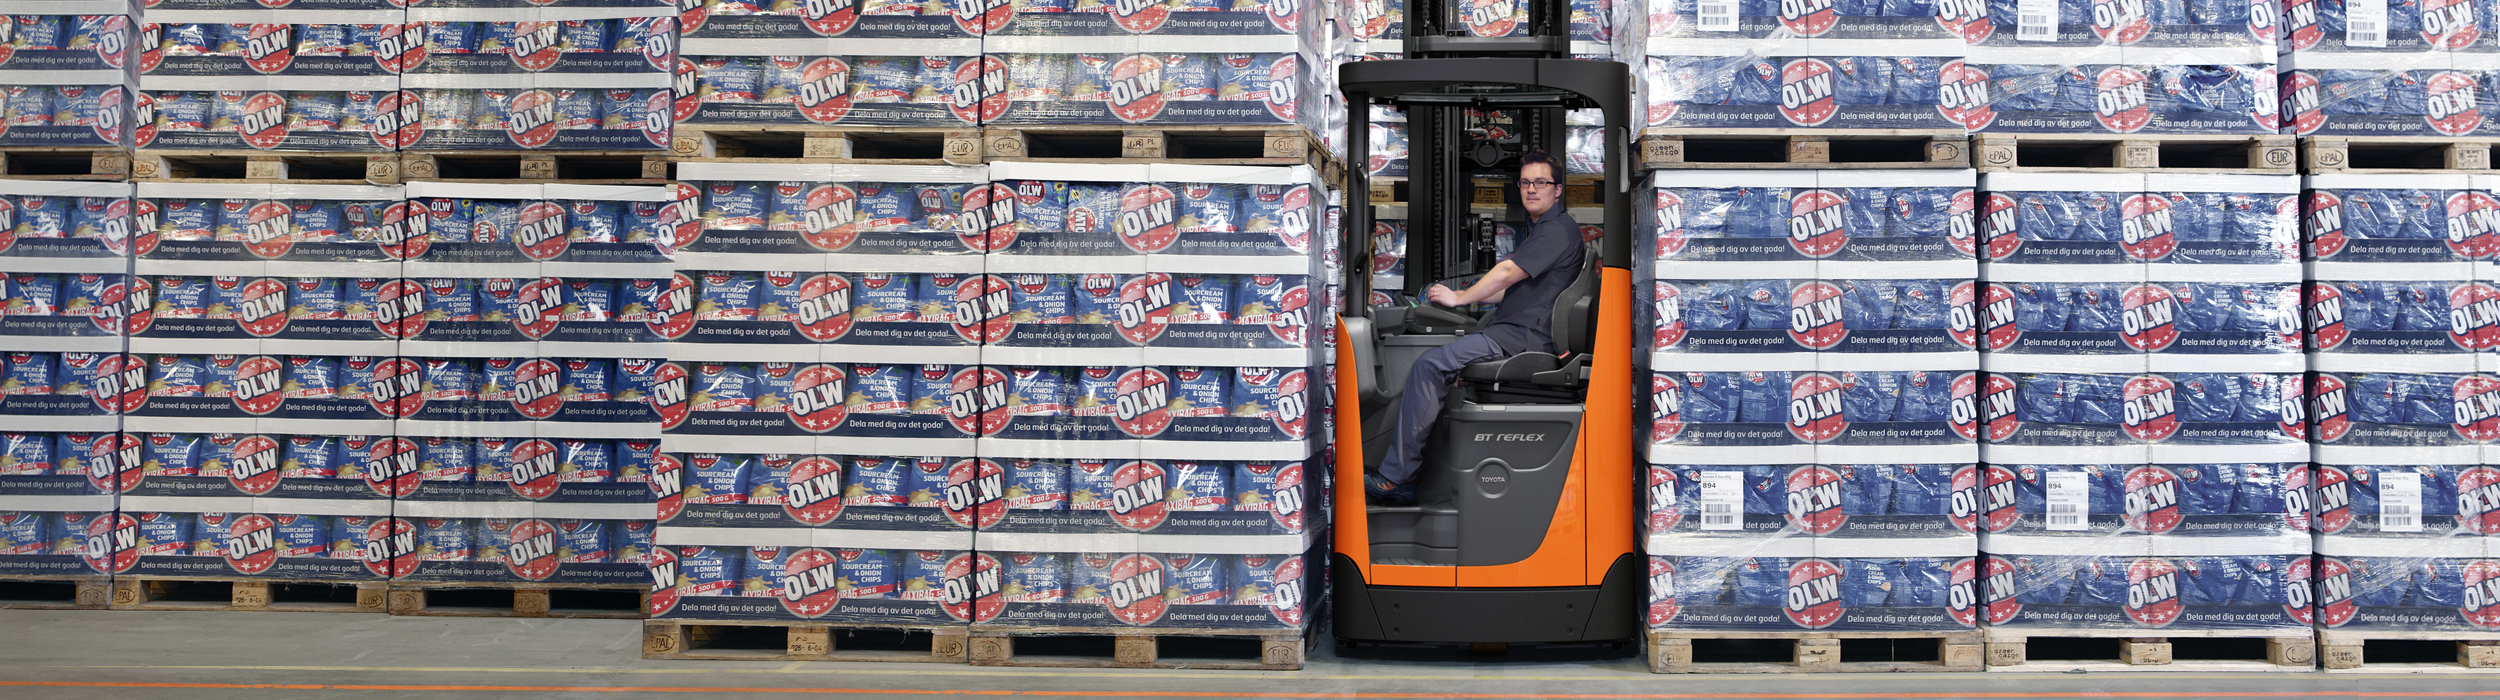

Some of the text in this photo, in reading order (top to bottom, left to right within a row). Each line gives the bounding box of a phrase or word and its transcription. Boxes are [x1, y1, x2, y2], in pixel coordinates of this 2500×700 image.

[248, 29, 289, 60] OLW
[514, 25, 557, 58] OLW
[894, 23, 905, 32] dig
[930, 23, 950, 32] goda!
[801, 70, 846, 107] OLW
[1112, 69, 1161, 108] OLW
[1781, 72, 1833, 111] OLW
[2098, 79, 2147, 118] OLW
[2281, 83, 2320, 122] OLW
[2429, 83, 2477, 120] OLW
[245, 106, 283, 136] OLW
[510, 101, 553, 135] OLW
[1680, 112, 1697, 120] Dela
[1699, 112, 1715, 120] med
[1716, 112, 1728, 121] dig
[1740, 112, 1753, 120] det
[1754, 112, 1775, 121] goda!
[2271, 152, 2288, 163] EUR
[431, 201, 451, 212] OLW
[1019, 184, 1042, 196] OLW
[247, 211, 289, 245] OLW
[520, 214, 564, 248] OLW
[805, 197, 855, 236] OLW
[1123, 198, 1173, 237] OLW
[1791, 204, 1844, 243] OLW
[1980, 207, 2018, 244] OLW
[2122, 209, 2172, 245] OLW
[2305, 204, 2344, 242] OLW
[490, 281, 510, 292] OLW
[1088, 278, 1111, 289] OLW
[242, 289, 286, 322] OLW
[517, 284, 561, 326] OLW
[799, 286, 850, 326] OLW
[1120, 281, 1171, 328] OLW
[1791, 296, 1844, 334] OLW
[1979, 299, 2017, 334] OLW
[2123, 297, 2175, 336] OLW
[2307, 297, 2345, 332] OLW
[1170, 330, 1187, 338] Dela
[1188, 330, 1204, 338] med
[1206, 330, 1218, 340] dig
[1243, 331, 1265, 340] goda!
[237, 368, 282, 400] OLW
[515, 370, 557, 405] OLW
[792, 378, 844, 417] OLW
[1117, 381, 1166, 422] OLW
[180, 402, 190, 410] dig
[212, 402, 230, 411] goda!
[1791, 387, 1843, 427] OLW
[1980, 389, 2018, 425] OLW
[2124, 388, 2176, 426] OLW
[2310, 389, 2348, 425] OLW
[1474, 433, 1494, 441] BT
[1851, 429, 1868, 437] Dela
[1887, 429, 1899, 438] dig
[1924, 429, 1945, 437] goda!
[233, 447, 277, 480] OLW
[512, 450, 555, 485] OLW
[788, 469, 840, 510] OLW
[1113, 474, 1163, 516] OLW
[1788, 481, 1840, 518] OLW
[2125, 481, 2178, 521] OLW
[229, 526, 273, 560] OLW
[509, 531, 553, 565] OLW
[785, 562, 836, 603] OLW
[1112, 567, 1161, 609] OLW
[1788, 573, 1840, 611] OLW
[1980, 571, 2017, 606] OLW
[2128, 573, 2178, 611] OLW
[2315, 571, 2353, 608] OLW
[681, 603, 699, 611] Dela
[700, 603, 716, 611] med
[718, 604, 729, 613] dig
[741, 604, 754, 612] det
[755, 604, 777, 613] goda!
[2222, 613, 2234, 622] dig
[2260, 613, 2281, 621] goda!
[652, 638, 668, 648] PAL
